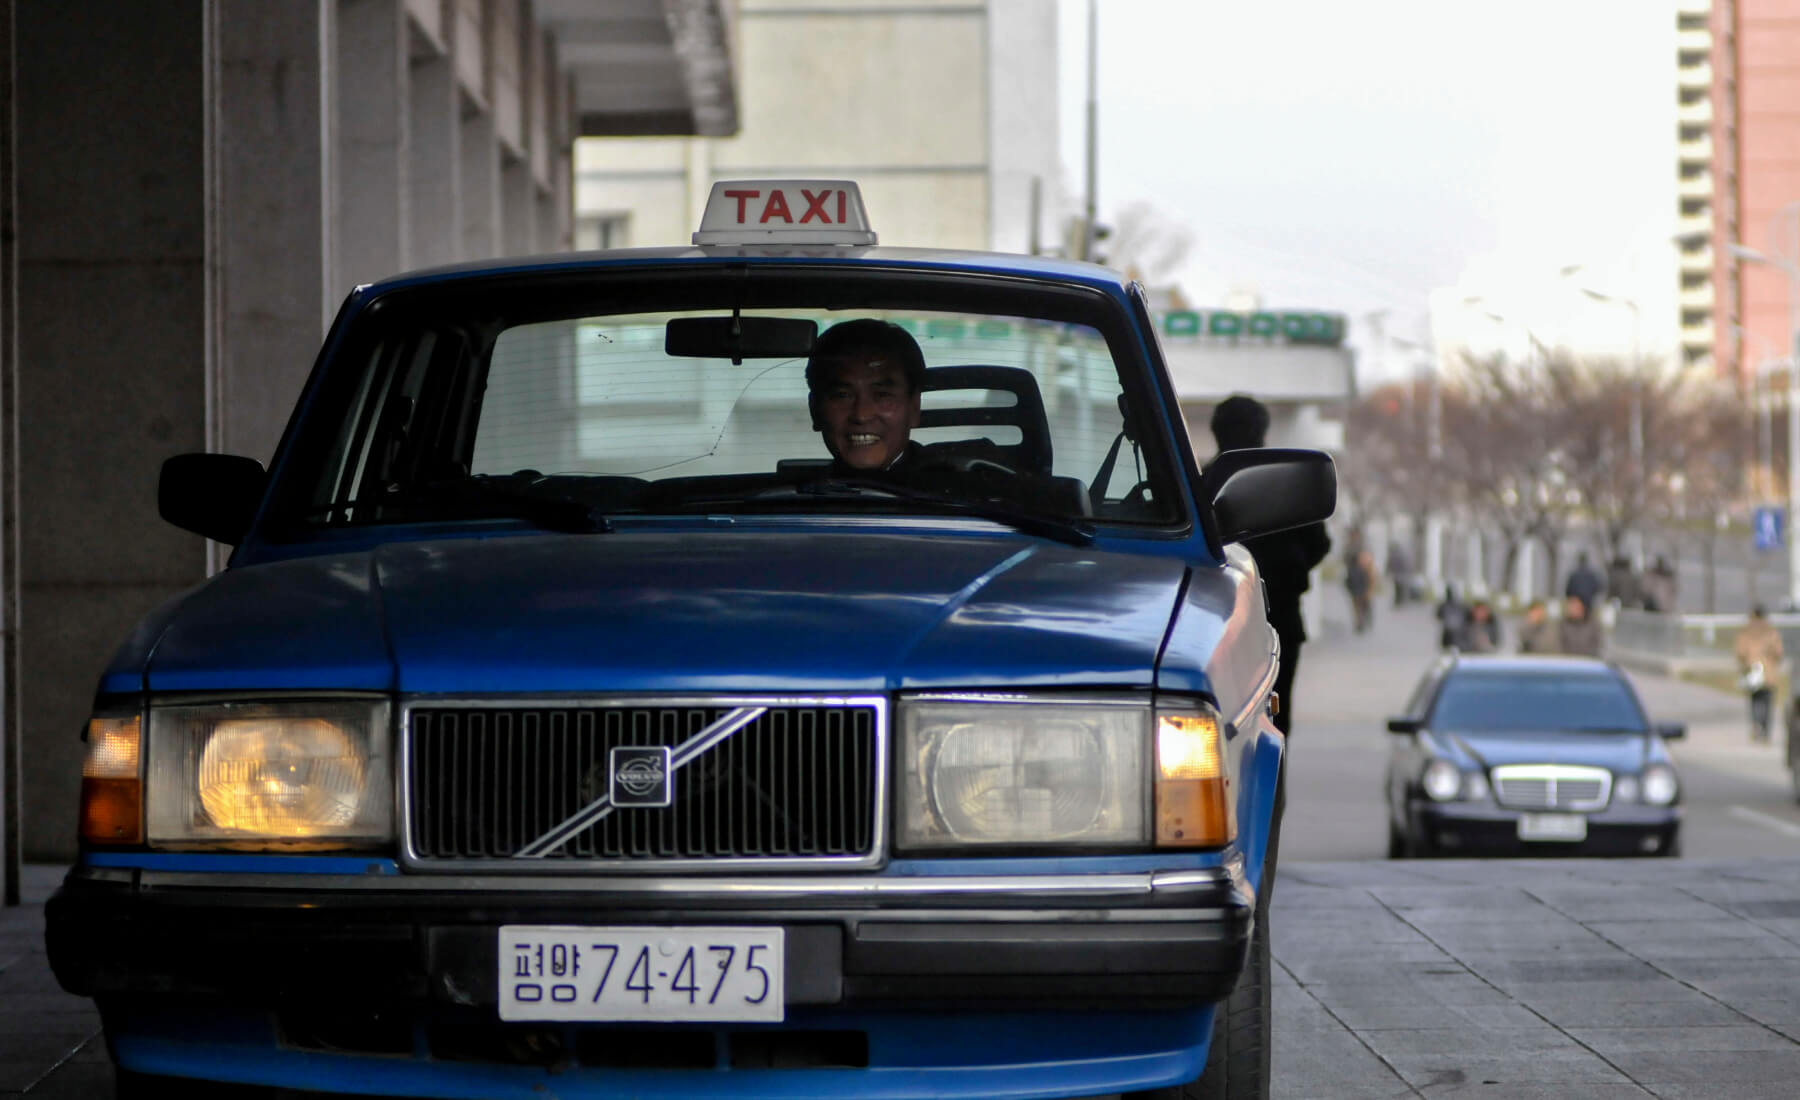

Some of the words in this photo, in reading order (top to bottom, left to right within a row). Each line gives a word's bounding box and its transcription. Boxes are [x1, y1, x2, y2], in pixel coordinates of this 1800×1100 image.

[724, 190, 847, 224] TAXI
[514, 944, 580, 1002] 평양
[592, 945, 769, 1004] 74-475
